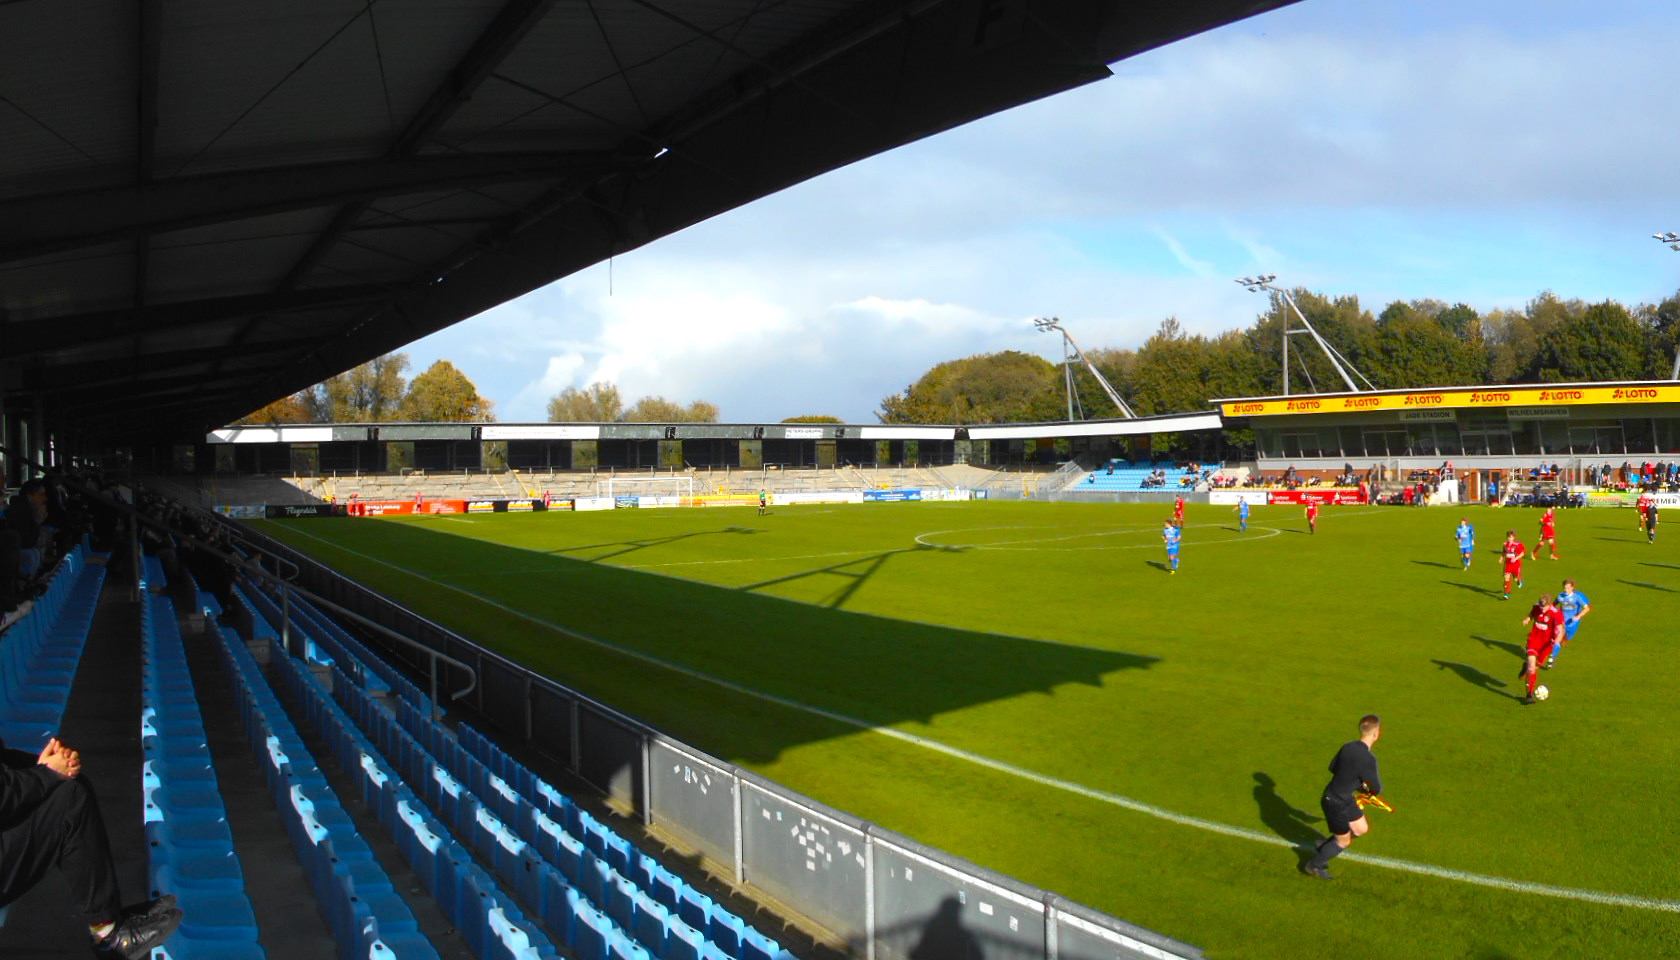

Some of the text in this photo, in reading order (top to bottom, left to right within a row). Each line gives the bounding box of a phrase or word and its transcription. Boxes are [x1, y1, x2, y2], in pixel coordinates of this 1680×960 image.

[1482, 393, 1510, 402] LOTTO
[1551, 391, 1581, 401] LOTTO
[1626, 389, 1657, 399] LOTTO
[1353, 399, 1379, 408] LOTTO
[1413, 396, 1441, 405] LOTTO
[1242, 404, 1263, 413] LOTTO
[1296, 401, 1320, 410] LOTTO
[1405, 411, 1450, 419] JADE STADION
[1508, 408, 1568, 417] WILHELMSHAVEN
